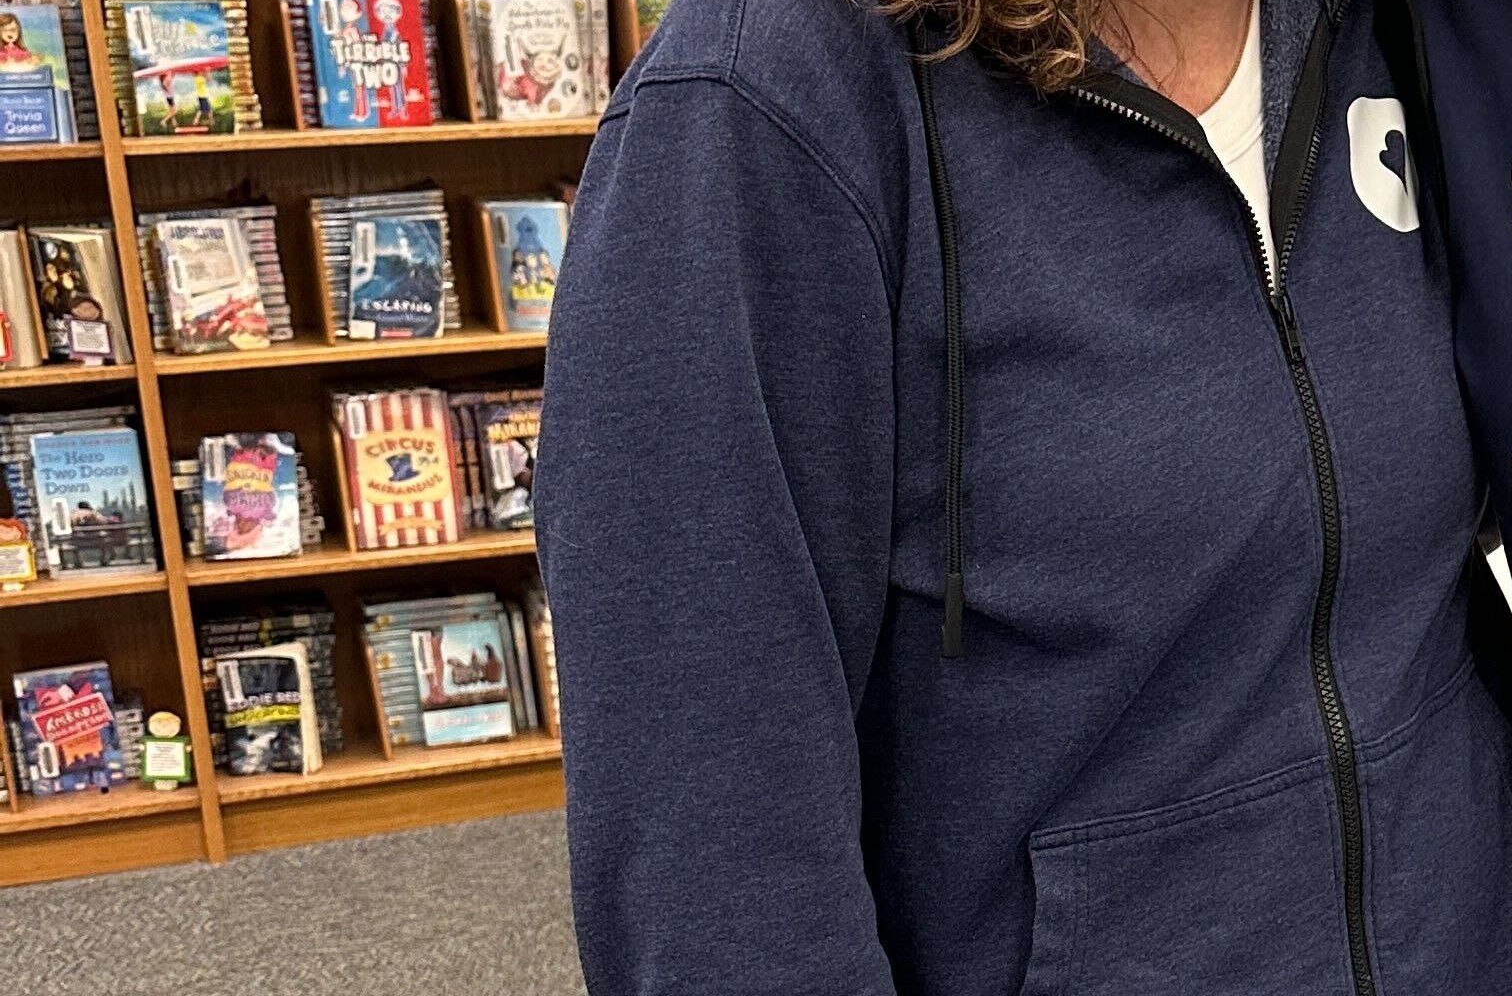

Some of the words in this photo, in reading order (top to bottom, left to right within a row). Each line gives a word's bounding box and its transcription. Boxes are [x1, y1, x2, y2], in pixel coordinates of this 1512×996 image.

[350, 61, 399, 88] TWO
[365, 437, 435, 458] CIRCUS
[64, 449, 106, 464] Hero
[41, 467, 78, 481] Two
[80, 464, 129, 479] Doors
[46, 481, 91, 495] Down
